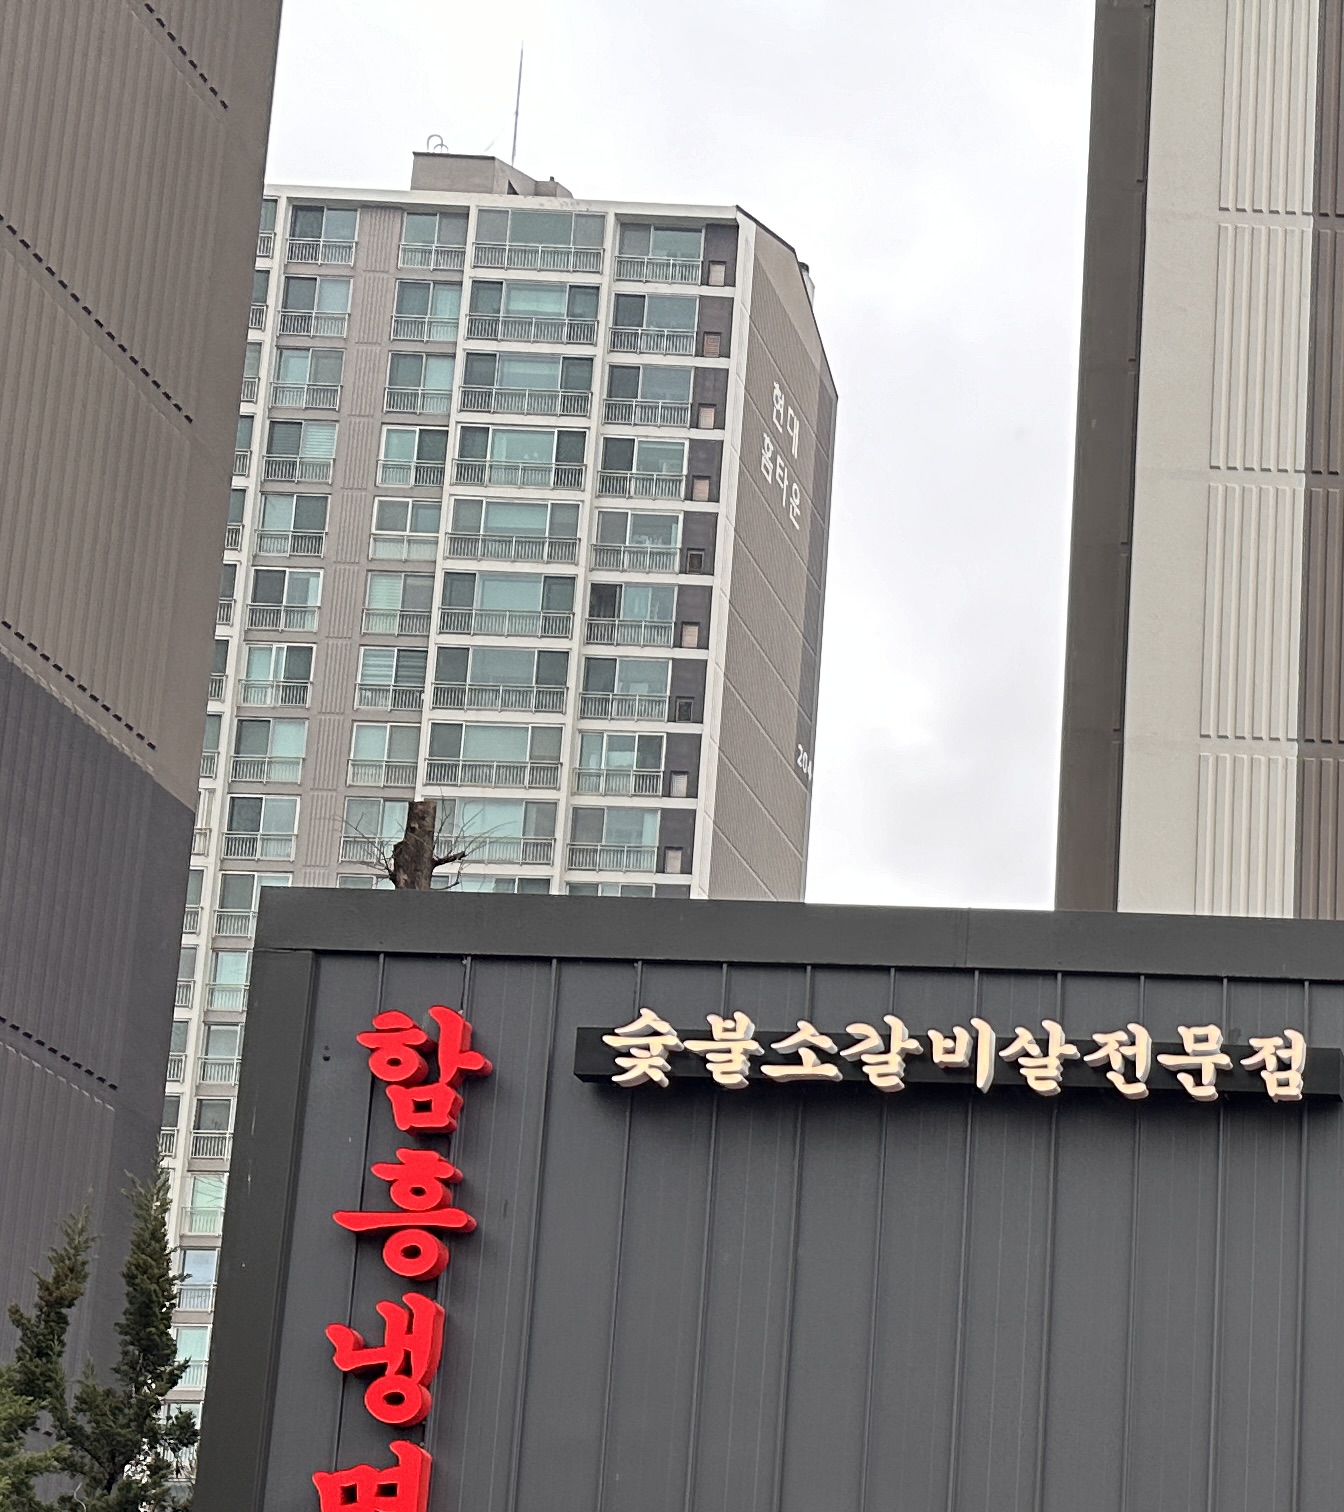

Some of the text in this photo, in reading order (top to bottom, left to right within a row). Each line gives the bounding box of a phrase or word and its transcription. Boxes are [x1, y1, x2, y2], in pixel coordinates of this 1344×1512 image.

[773, 381, 799, 459] 현대
[761, 433, 800, 530] 홈타운
[602, 1007, 1309, 1102] 숯불소갈비살전문점
